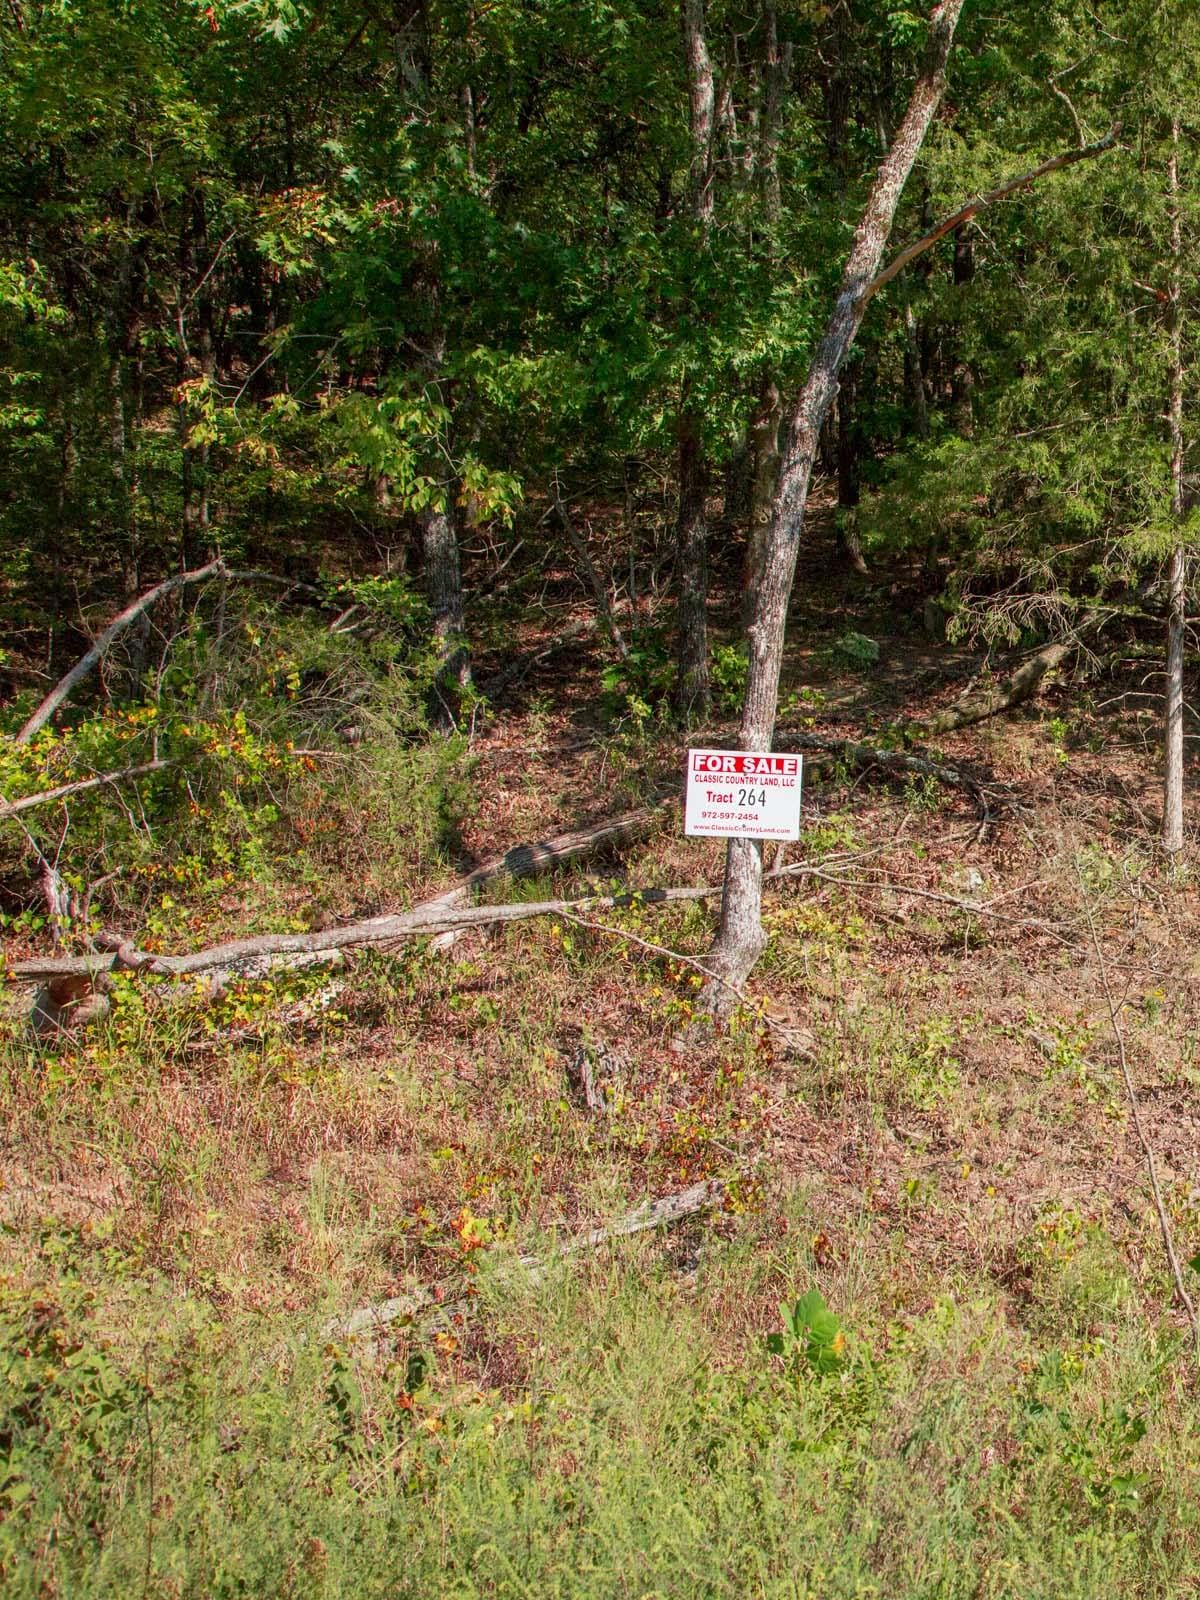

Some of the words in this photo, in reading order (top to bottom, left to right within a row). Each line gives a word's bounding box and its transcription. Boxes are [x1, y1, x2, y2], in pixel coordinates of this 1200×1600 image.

[695, 756, 736, 771] FOR
[742, 757, 796, 774] SALE
[694, 774, 724, 783] CLASSIC
[725, 775, 758, 785] COUNTRY
[760, 777, 780, 788] LAND,
[782, 778, 795, 787] LLC
[706, 791, 733, 803] Tract
[738, 788, 766, 807] 264
[702, 811, 758, 820] 972-597-2454
